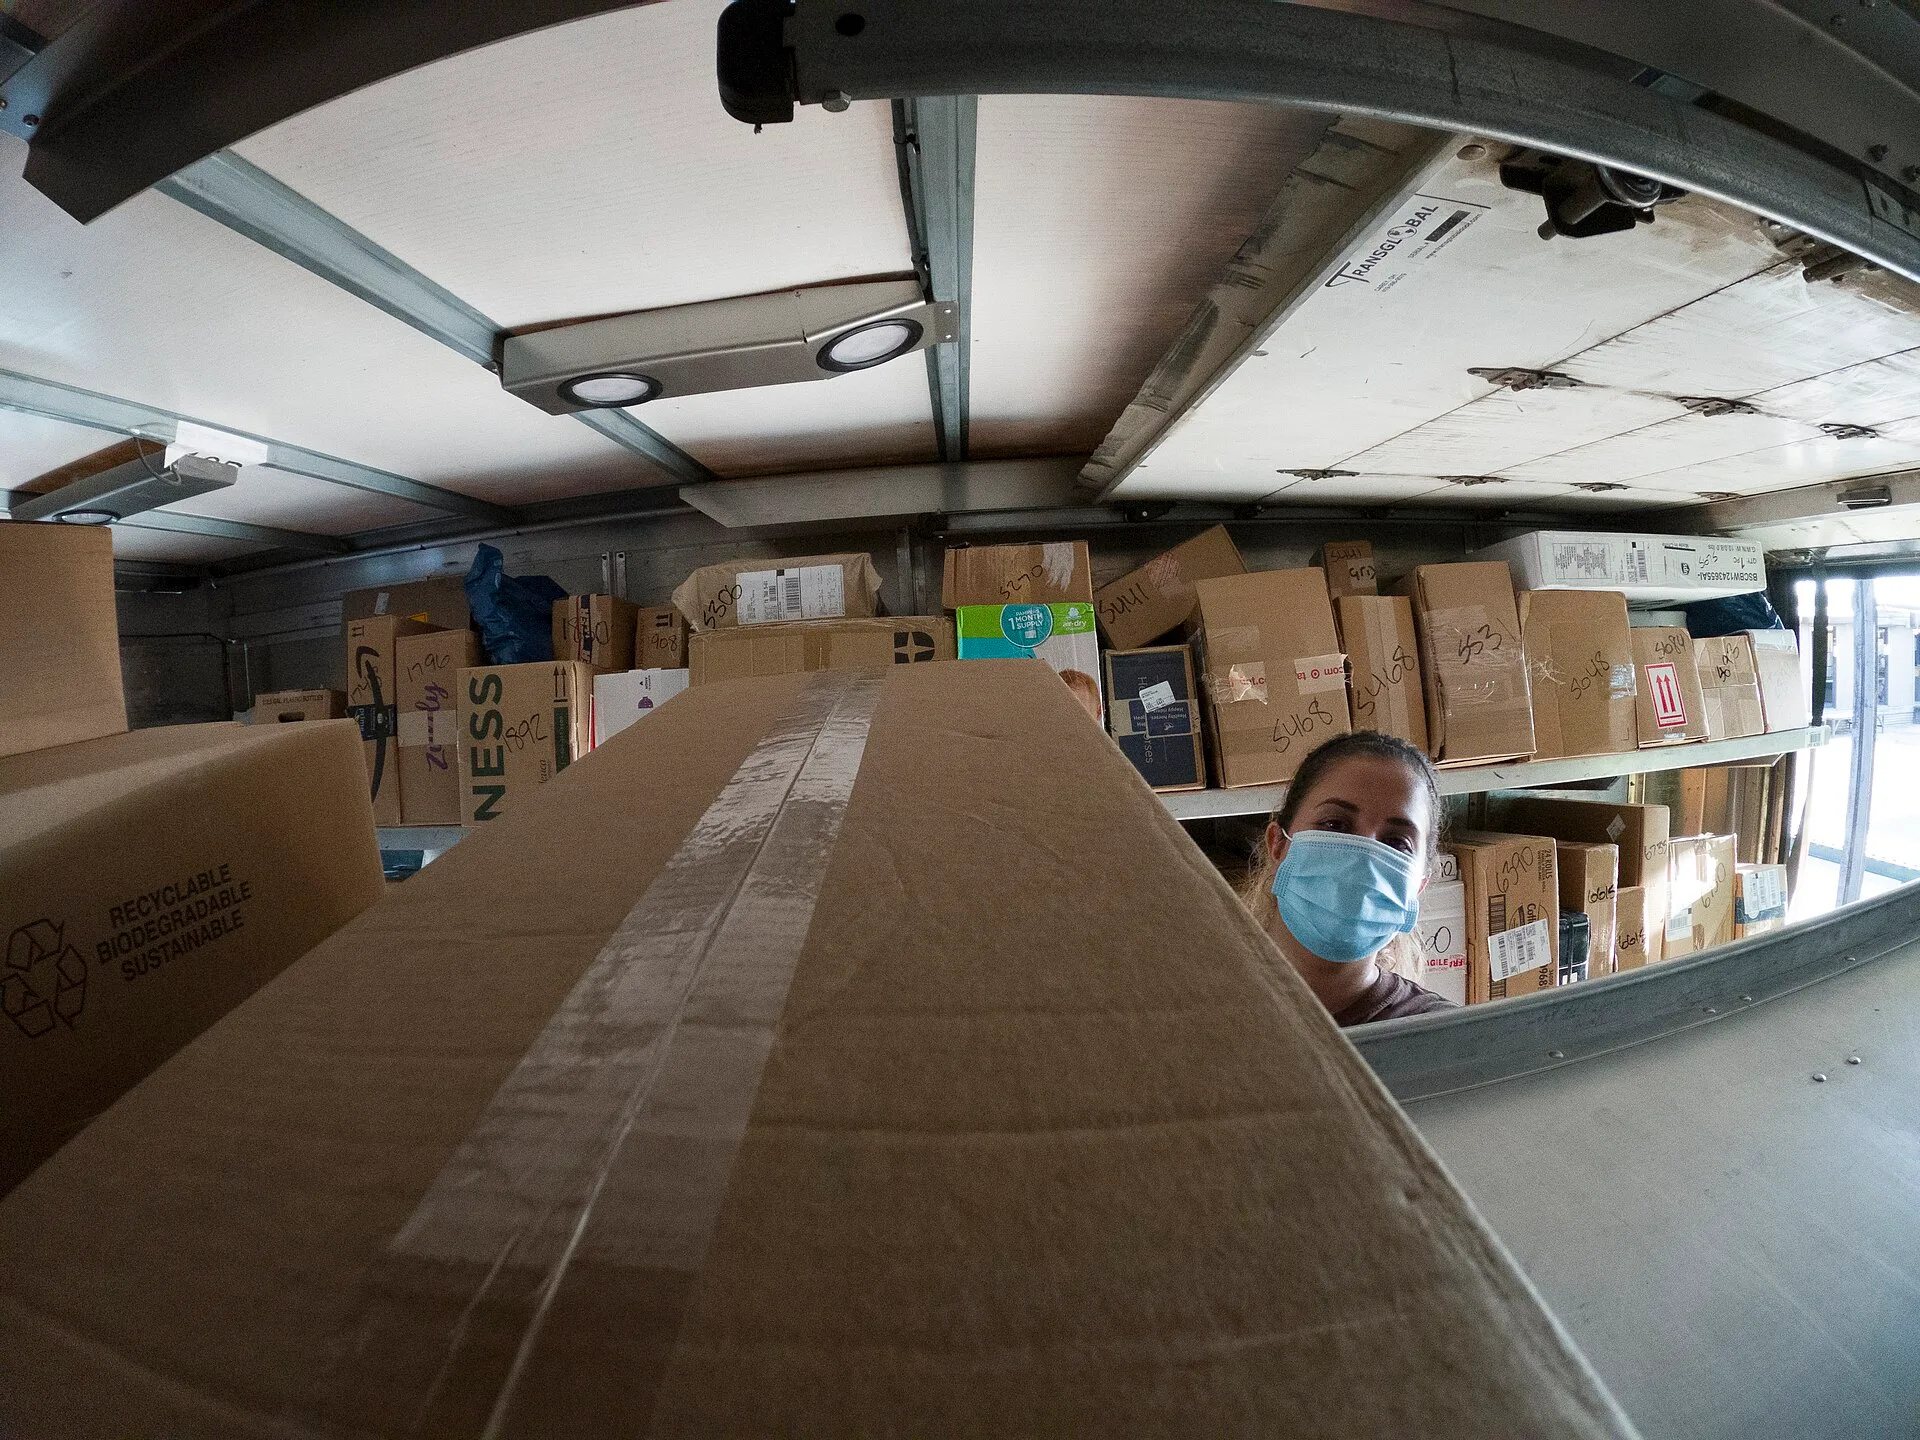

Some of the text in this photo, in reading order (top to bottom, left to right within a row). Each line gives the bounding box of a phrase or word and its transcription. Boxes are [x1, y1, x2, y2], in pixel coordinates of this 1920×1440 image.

[1325, 204, 1439, 287] TRANSGLOBAL
[703, 584, 743, 629] 5306
[1008, 617, 1015, 630] 1
[1015, 612, 1043, 622] MONTH
[1016, 619, 1043, 629] SUPPLY
[1357, 645, 1416, 716] 5468
[468, 672, 506, 822] NESS
[502, 713, 548, 753] 1892
[1272, 696, 1333, 754] 5468
[109, 863, 233, 929] RECYCLABLE
[1497, 846, 1535, 896] 6390
[1588, 885, 1616, 903] 6615
[96, 880, 252, 965] BIODEGRADABLE
[120, 908, 245, 982] SUSTAINABLE
